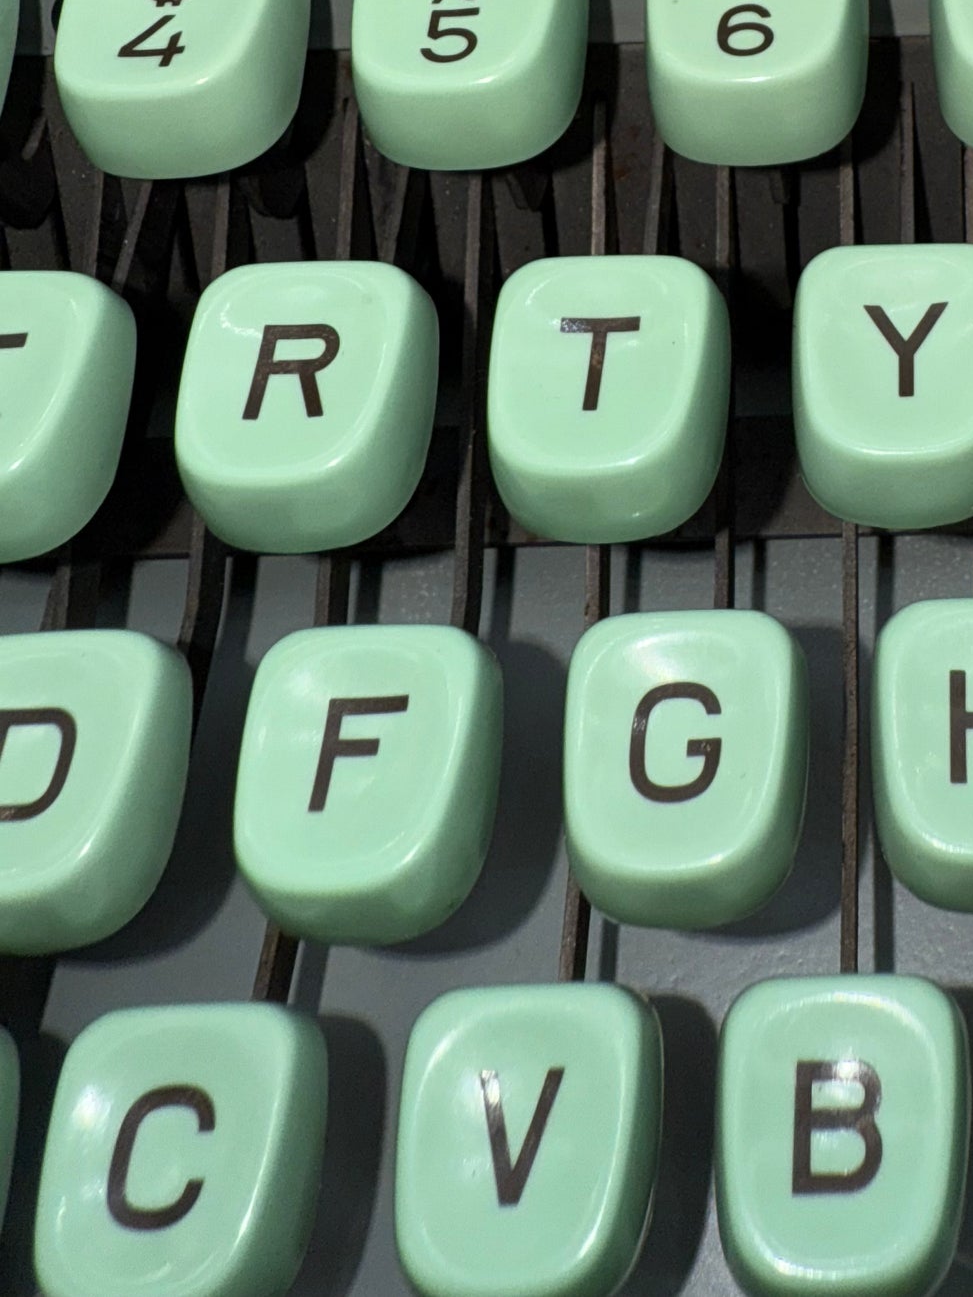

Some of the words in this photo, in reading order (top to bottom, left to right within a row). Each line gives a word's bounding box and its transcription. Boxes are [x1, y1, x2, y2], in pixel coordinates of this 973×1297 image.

[117, 14, 186, 68] 4
[420, 7, 480, 64] 5
[716, 3, 775, 57] 6
[241, 323, 341, 421] R
[561, 316, 641, 412] T
[863, 301, 949, 398] Y
[307, 694, 410, 813] F
[628, 681, 723, 804] G
[106, 1084, 216, 1233] C
[479, 1066, 565, 1207] V
[791, 1060, 883, 1196] B
